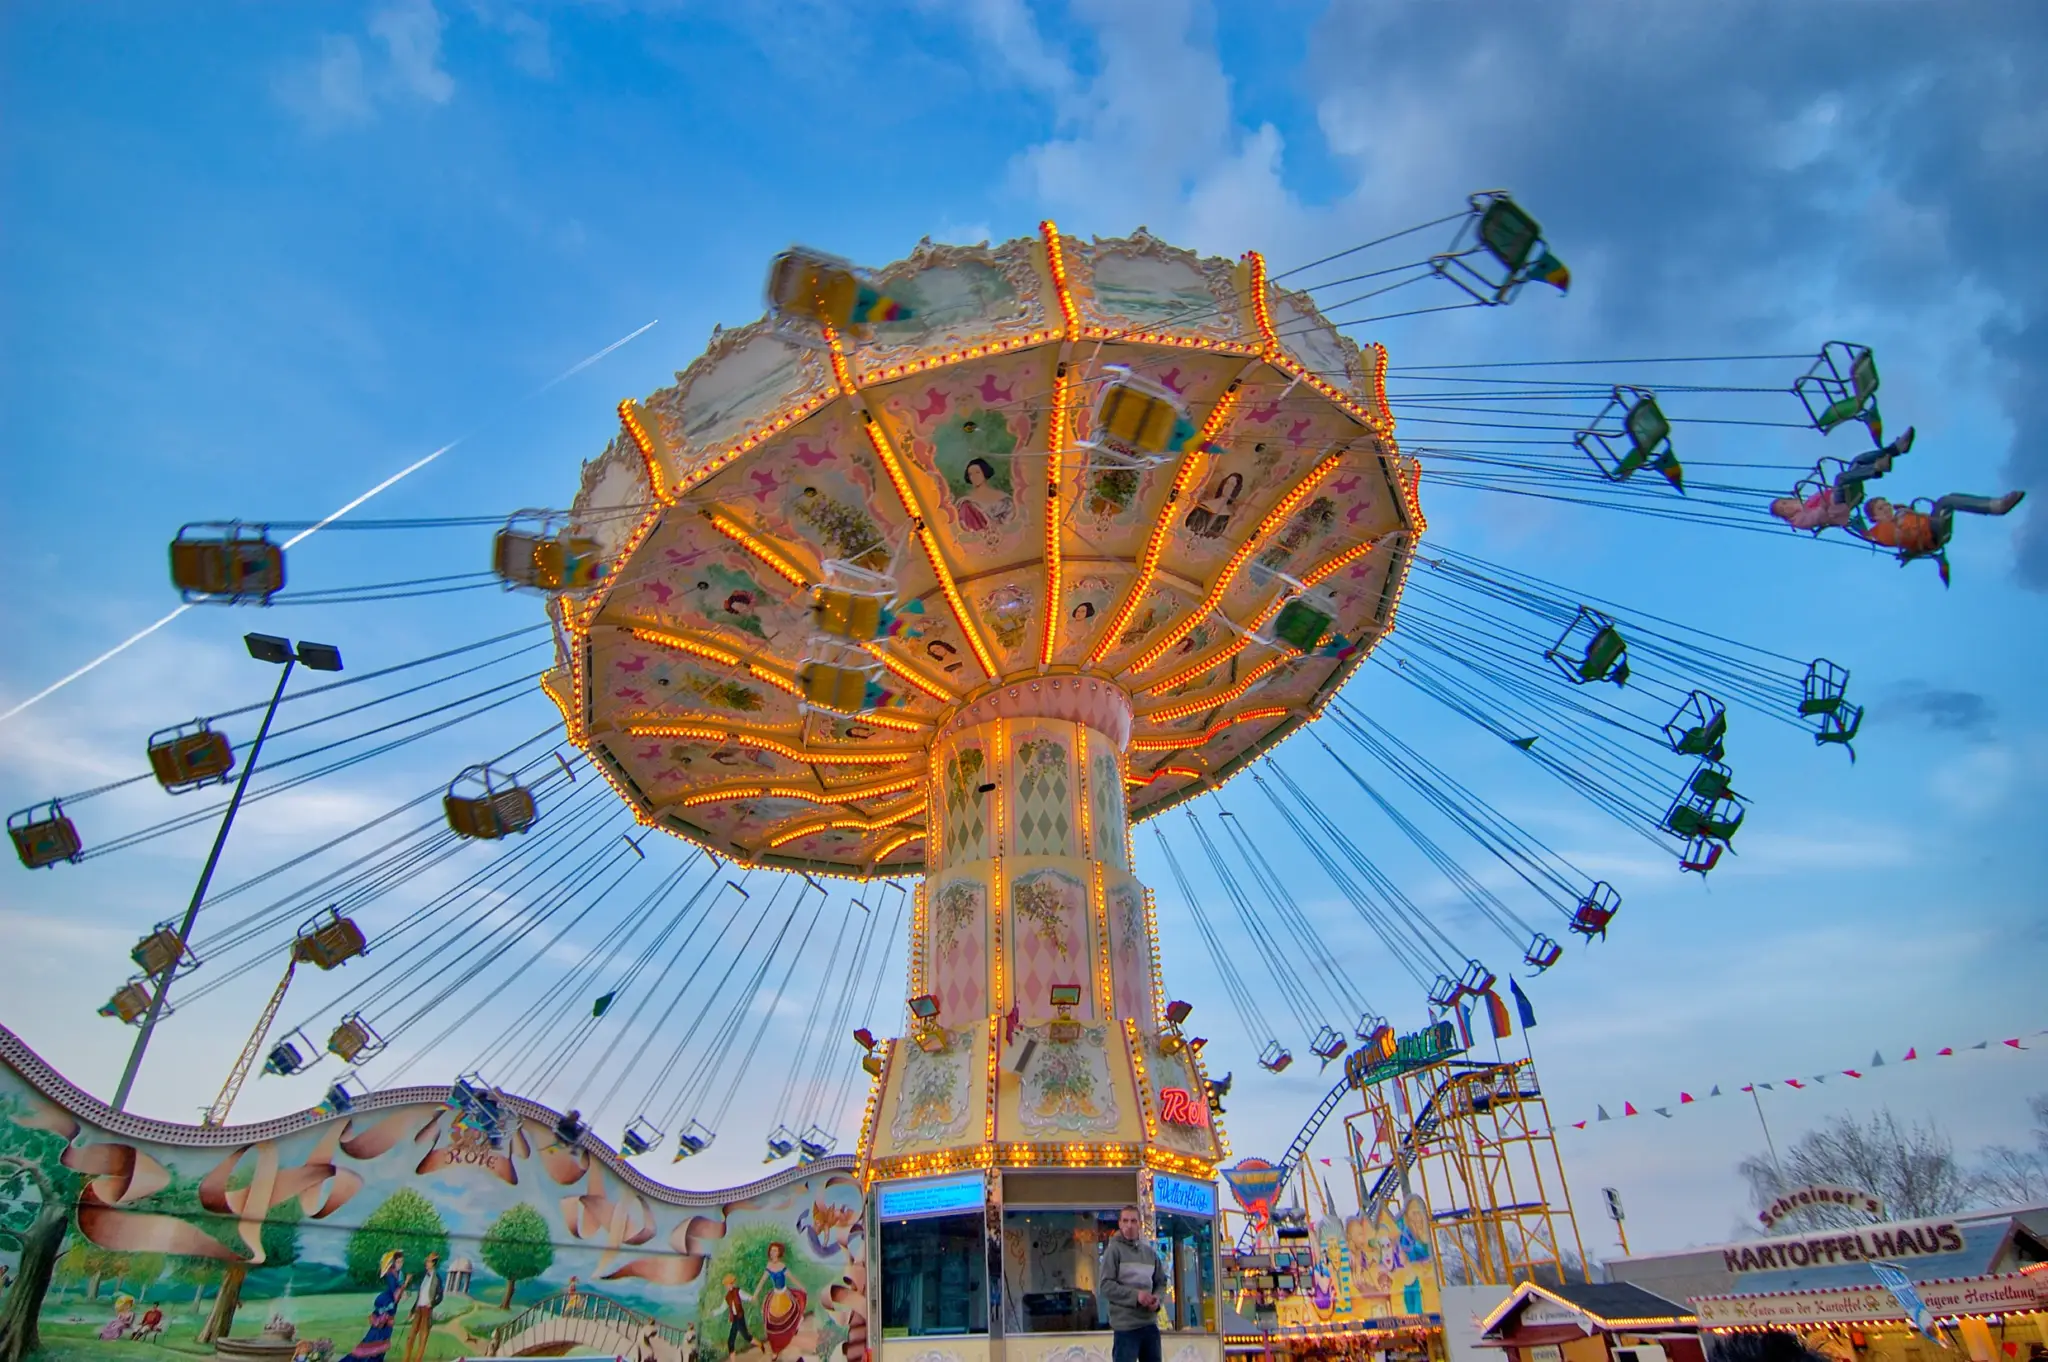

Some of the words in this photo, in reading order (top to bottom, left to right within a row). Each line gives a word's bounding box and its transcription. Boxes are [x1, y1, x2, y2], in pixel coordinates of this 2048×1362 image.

[1759, 1184, 1880, 1229] Schreiner's
[1722, 1223, 1963, 1274] KARTOFFELHAUS
[1924, 1292, 1960, 1309] eigene
[1964, 1285, 2036, 1305] Herstellung
